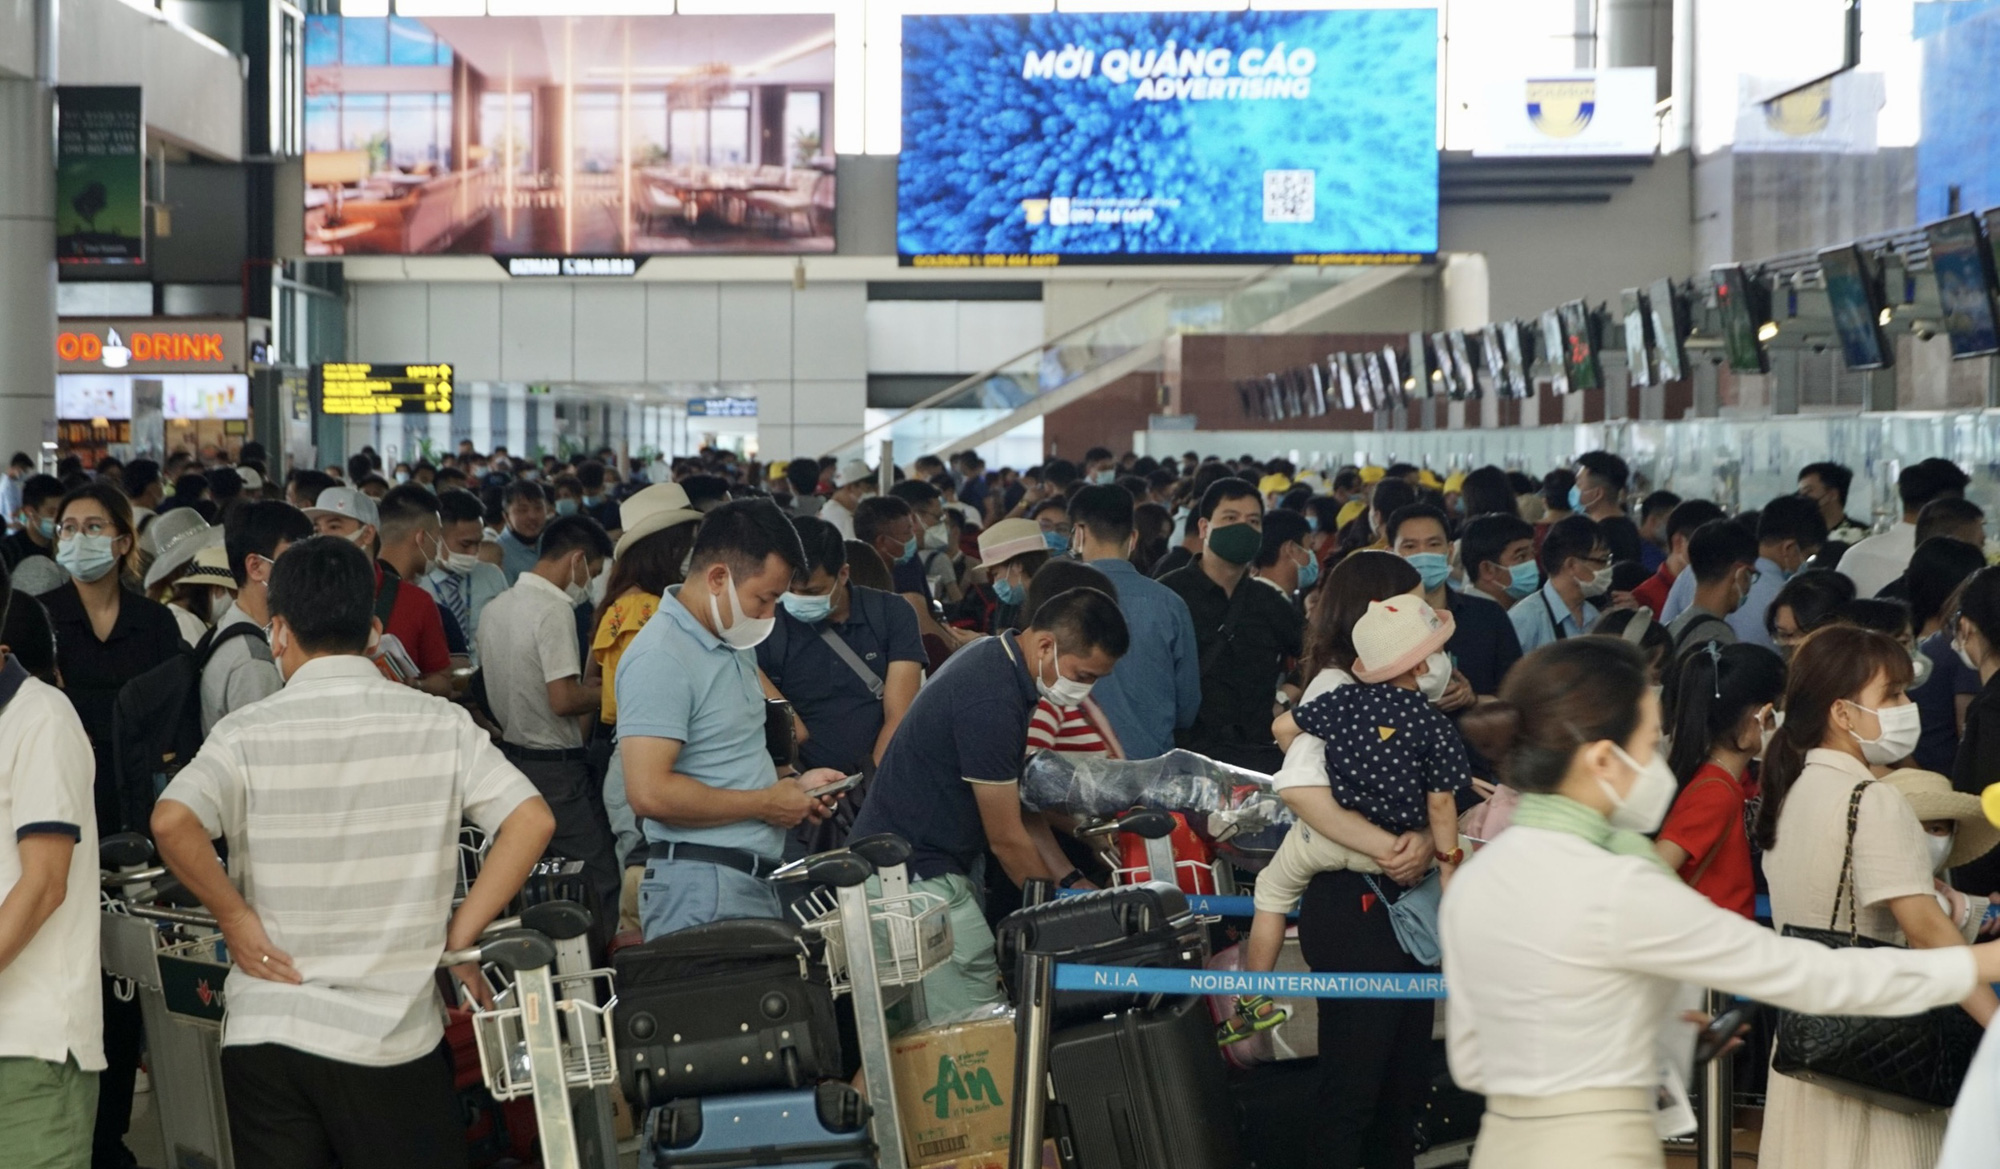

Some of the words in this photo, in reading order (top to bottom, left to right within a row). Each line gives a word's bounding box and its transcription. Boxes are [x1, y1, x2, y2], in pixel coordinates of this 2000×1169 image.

[1022, 44, 1094, 80] MỜI
[1100, 40, 1231, 83] QUẢNG
[1237, 42, 1317, 79] CÁO
[1133, 78, 1312, 101] ADVERTISING
[131, 332, 224, 362] DRINK
[1094, 970, 1139, 988] N.I.A
[1190, 974, 1253, 991] NOIBAI
[1257, 975, 1405, 993] INTERNATIONAL
